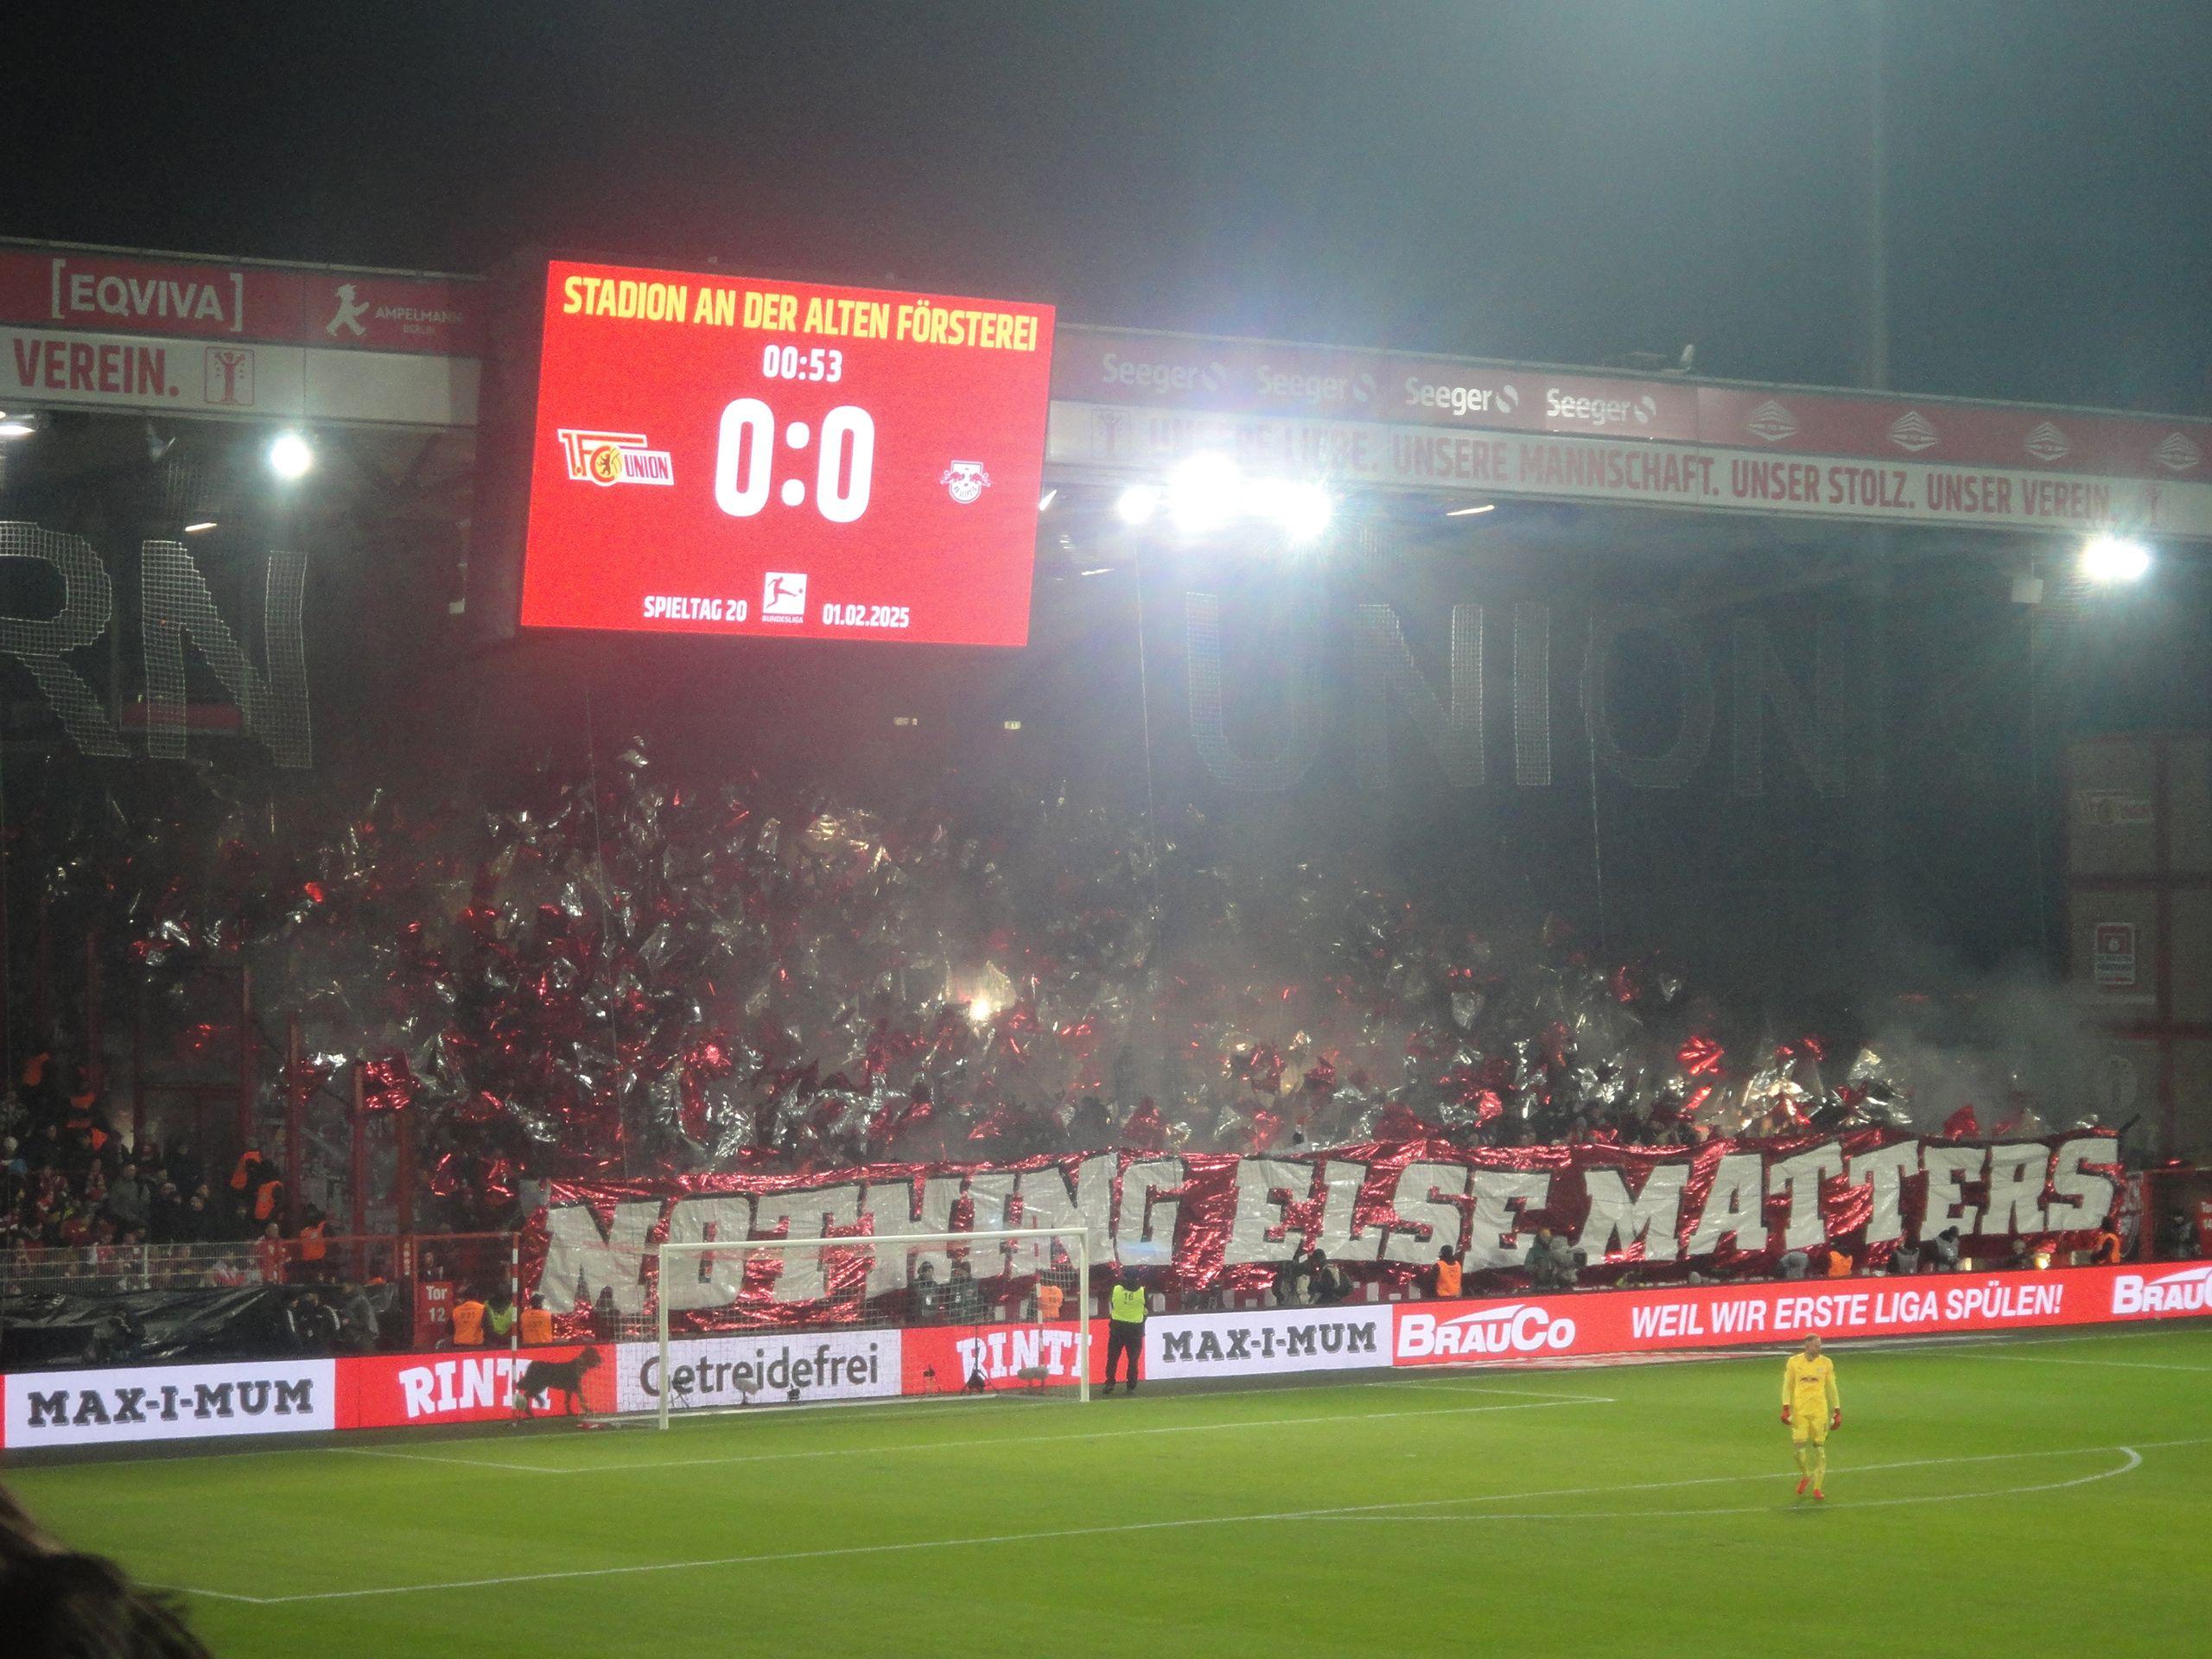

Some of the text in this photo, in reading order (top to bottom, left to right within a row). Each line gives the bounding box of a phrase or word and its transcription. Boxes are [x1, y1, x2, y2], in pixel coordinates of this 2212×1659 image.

[563, 276, 1038, 352] STADION AN DER ALTEN FÖRSTEREI
[13, 337, 180, 397] VEREIN.
[762, 344, 842, 383] 00:53
[1103, 353, 1198, 392] Seeger
[1258, 365, 1348, 404] Seeger
[1404, 377, 1493, 415] Seeger
[1547, 388, 1630, 426] Seeger
[624, 454, 669, 479] UNION
[715, 397, 875, 523] 0:0
[1393, 437, 1508, 482] UNSERE
[1518, 442, 1719, 497] MANNSCHAFT.
[1732, 458, 1819, 504] UNSER
[1828, 466, 1915, 510] STOLZ.
[1927, 474, 2011, 514] UNSER
[643, 595, 747, 622] SPIELTAG 20
[761, 614, 804, 624] BUNDESLIGA
[823, 603, 910, 628] 01.02.2025
[539, 1138, 2120, 1313] NOTHING ELSE MATTERS
[426, 1285, 448, 1300] Tor
[1631, 1283, 2063, 1338] WEIL WIR ERSTE LIGA SPÜLEN!
[429, 1307, 446, 1322] 12
[1162, 1321, 1377, 1363] MAX-I-MUM
[640, 1342, 878, 1396] Getreidefrei
[28, 1378, 314, 1427] MAX-I-MUM
